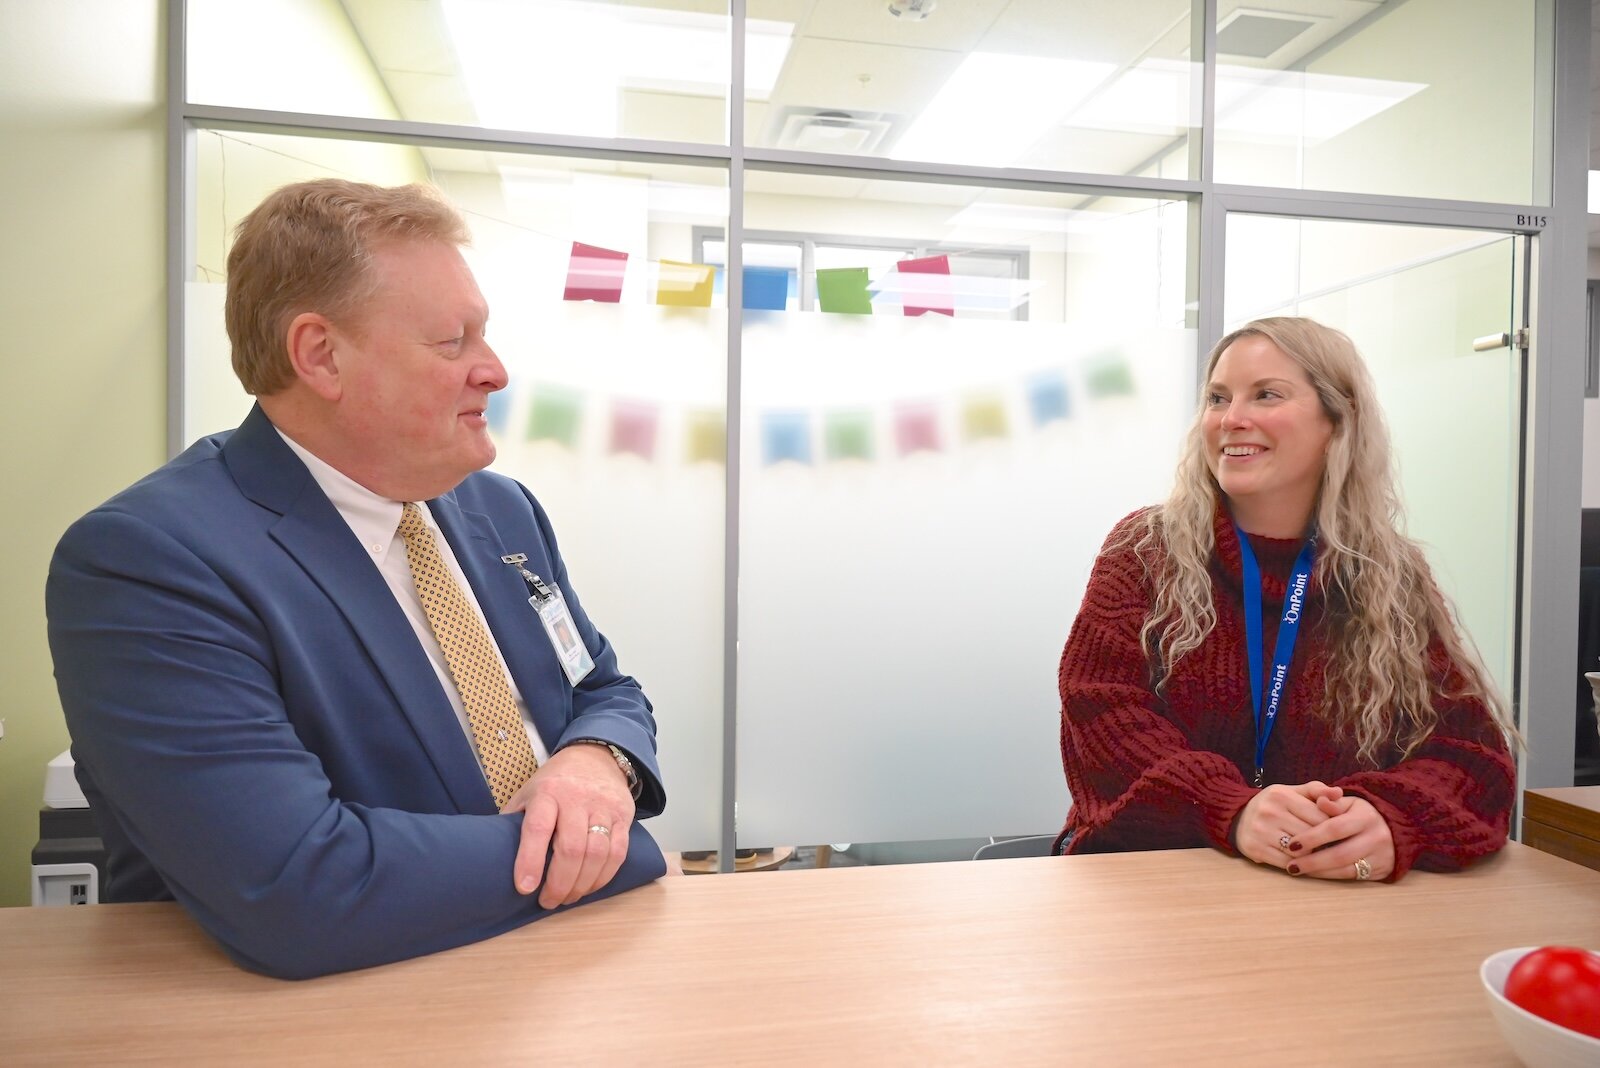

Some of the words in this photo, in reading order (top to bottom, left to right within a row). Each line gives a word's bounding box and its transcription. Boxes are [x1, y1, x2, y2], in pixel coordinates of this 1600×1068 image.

[1517, 215, 1547, 228] B115
[1285, 573, 1308, 623] OnPoint
[1267, 664, 1287, 717] OnPoint
